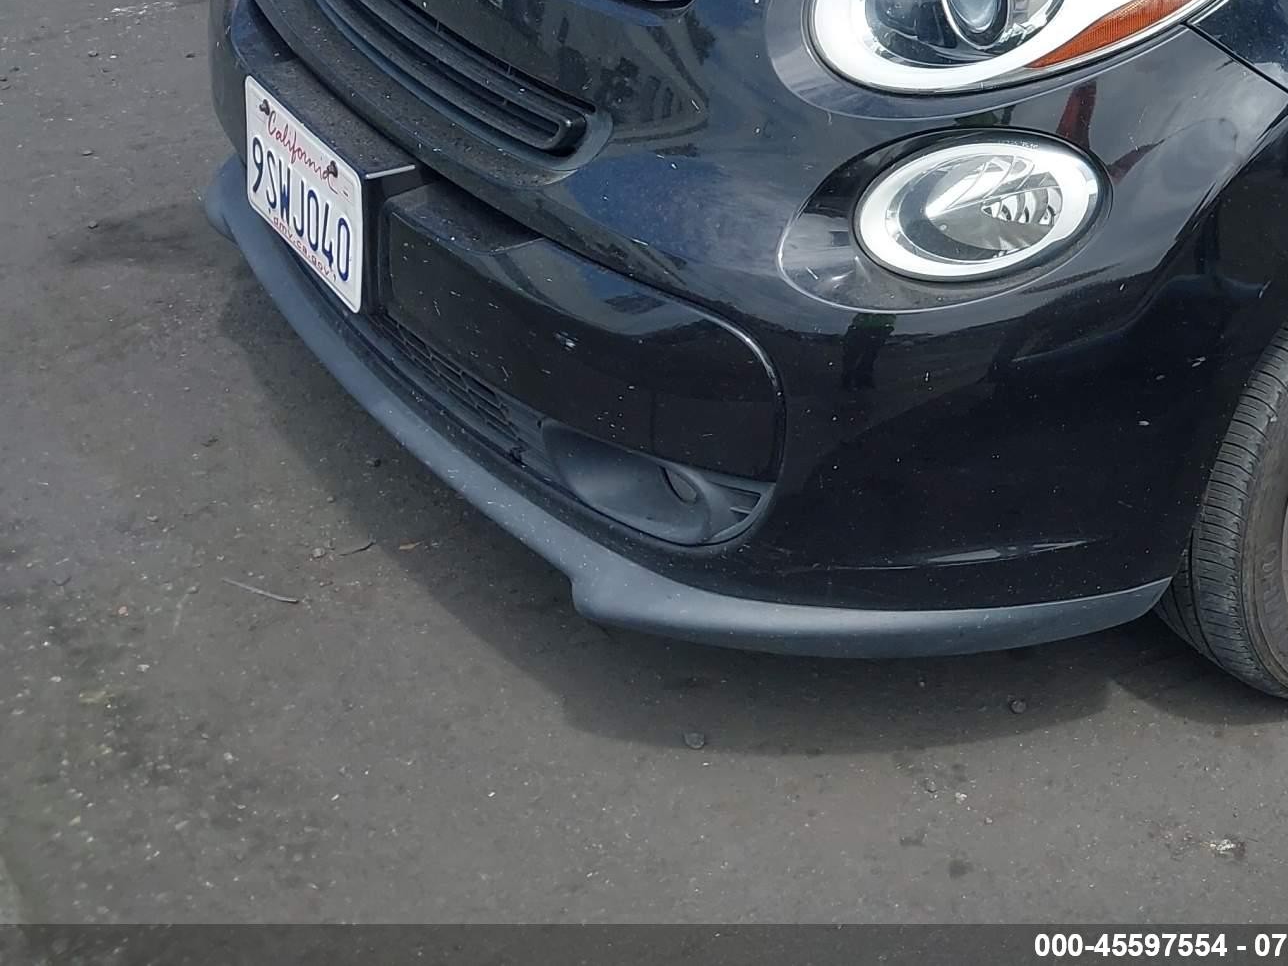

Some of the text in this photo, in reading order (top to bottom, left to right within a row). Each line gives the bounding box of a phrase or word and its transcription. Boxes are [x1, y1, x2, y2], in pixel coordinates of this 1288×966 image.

[267, 110, 338, 195] California
[252, 136, 351, 282] 9SWJ040
[272, 215, 333, 276] dmv.ca.gov
